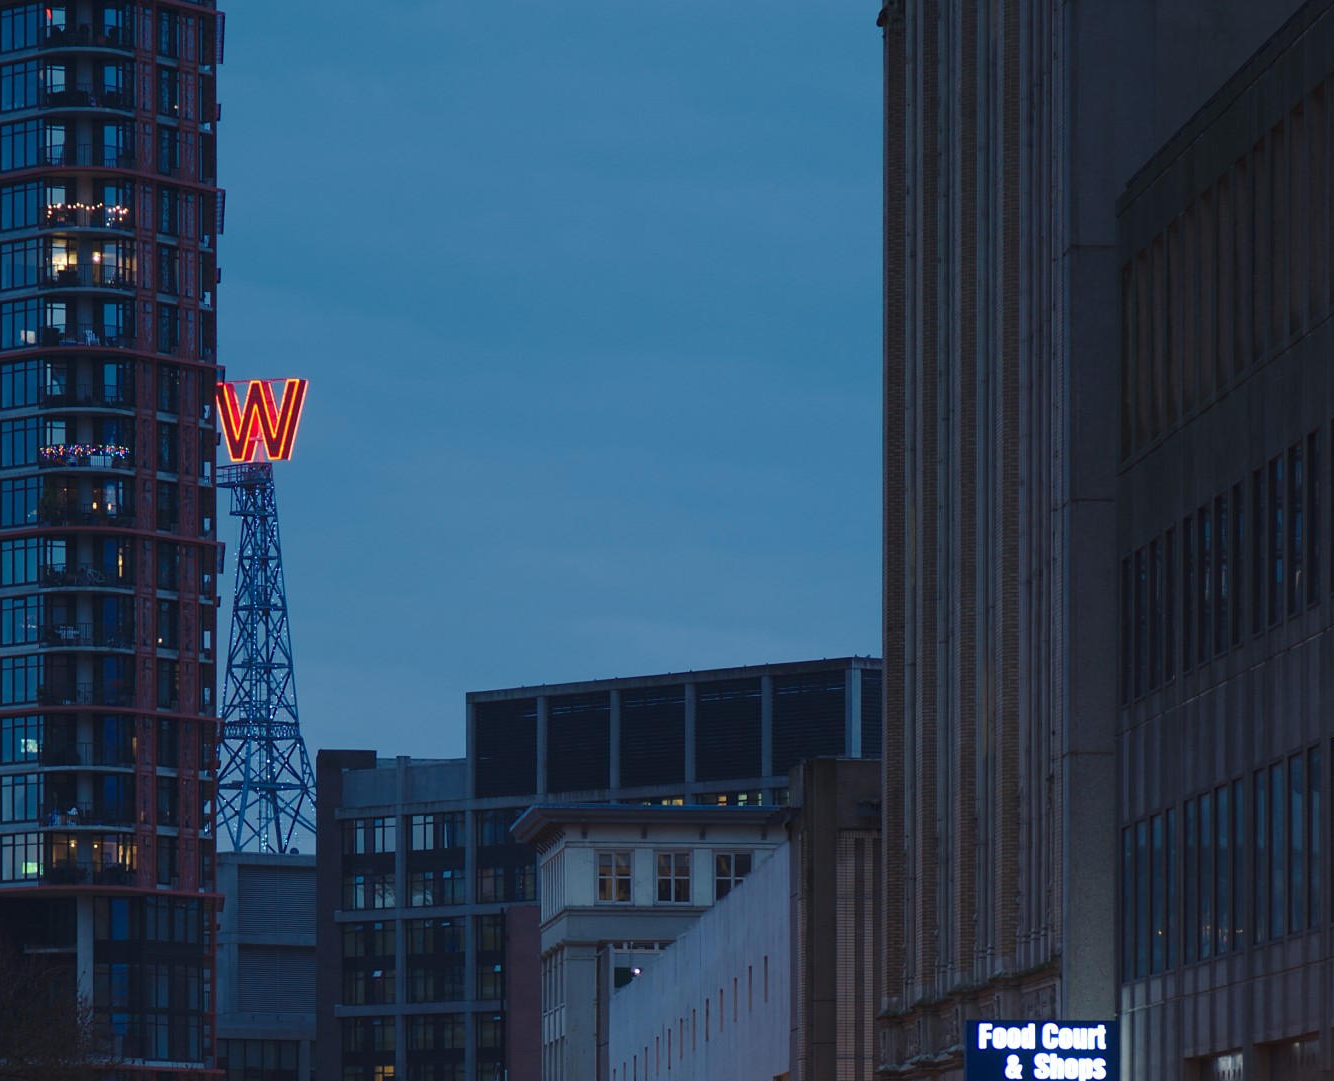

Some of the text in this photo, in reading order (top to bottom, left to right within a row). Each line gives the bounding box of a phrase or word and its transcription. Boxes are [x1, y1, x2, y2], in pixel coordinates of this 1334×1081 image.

[216, 378, 308, 462] W
[978, 1023, 1106, 1050] Food Court
[1005, 1053, 1106, 1081] & Shops
